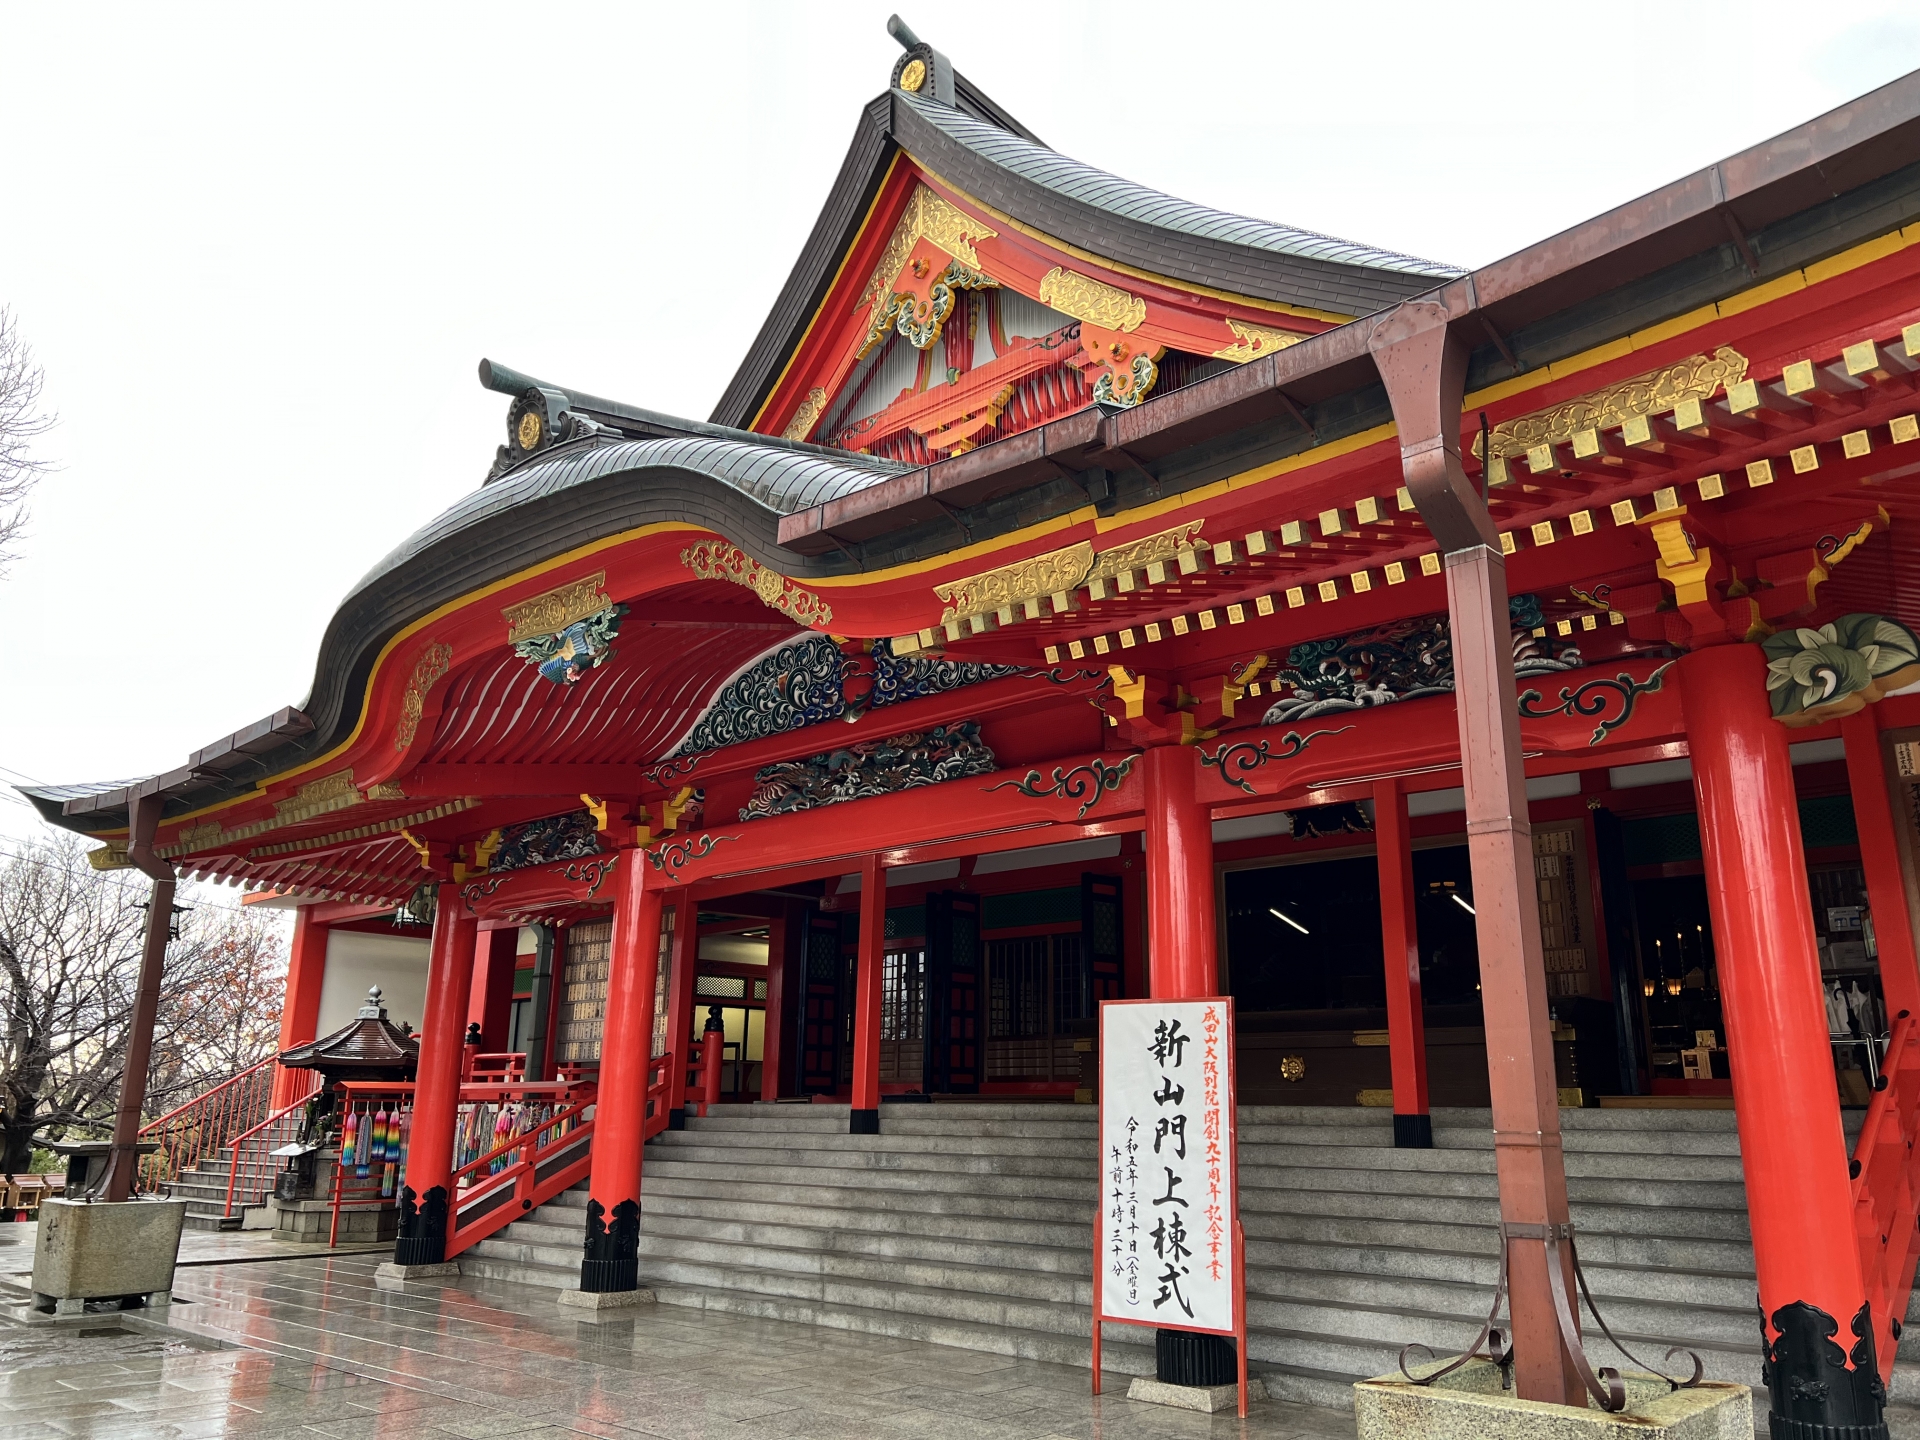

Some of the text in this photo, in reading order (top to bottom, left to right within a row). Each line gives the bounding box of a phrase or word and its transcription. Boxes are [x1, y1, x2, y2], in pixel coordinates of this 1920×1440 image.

[1109, 1145, 1125, 1276] 午前十時三十分
[1125, 1116, 1140, 1305] 令和五年三月十日(金曜日)
[1147, 1019, 1194, 1319] 新山門上棟式
